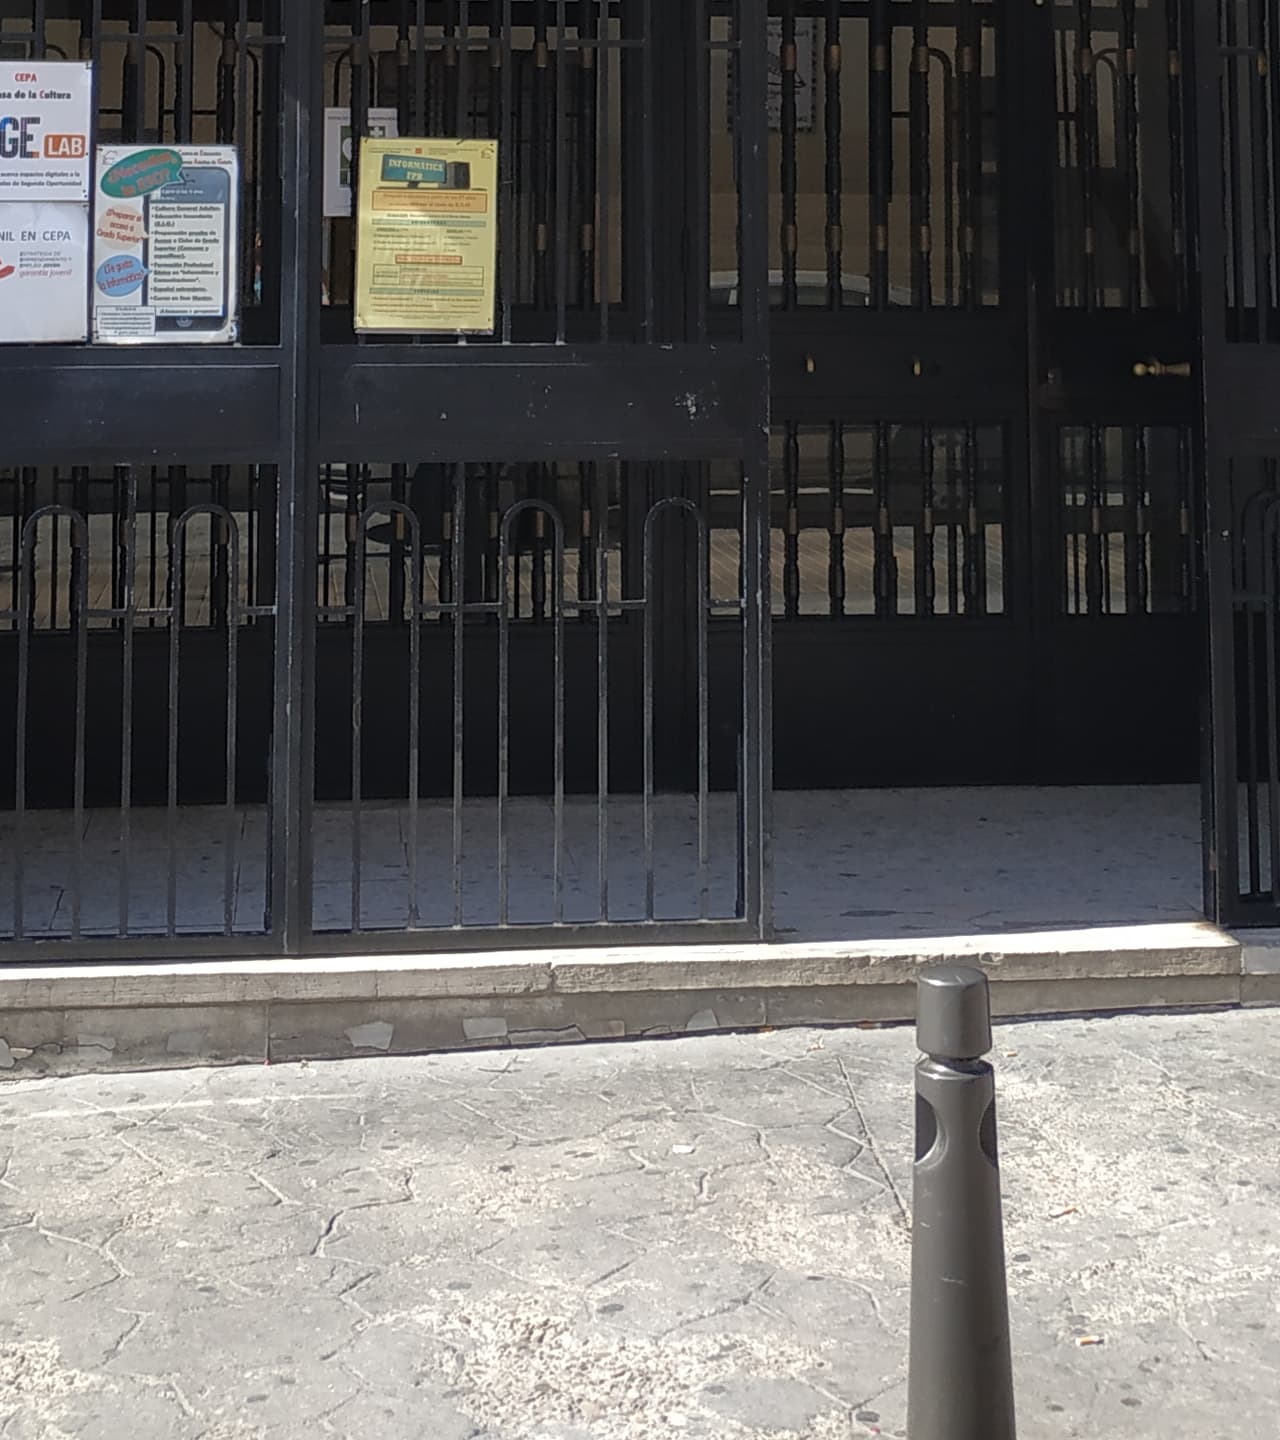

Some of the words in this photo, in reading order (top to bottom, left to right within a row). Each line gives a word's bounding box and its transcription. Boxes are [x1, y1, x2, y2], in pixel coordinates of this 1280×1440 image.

[15, 73, 37, 82] CEPA
[15, 90, 26, 99] de
[29, 90, 36, 99] la
[39, 90, 71, 99] Cultura
[48, 137, 82, 155] LAB
[21, 232, 36, 241] EN
[43, 231, 71, 241] CEPA
